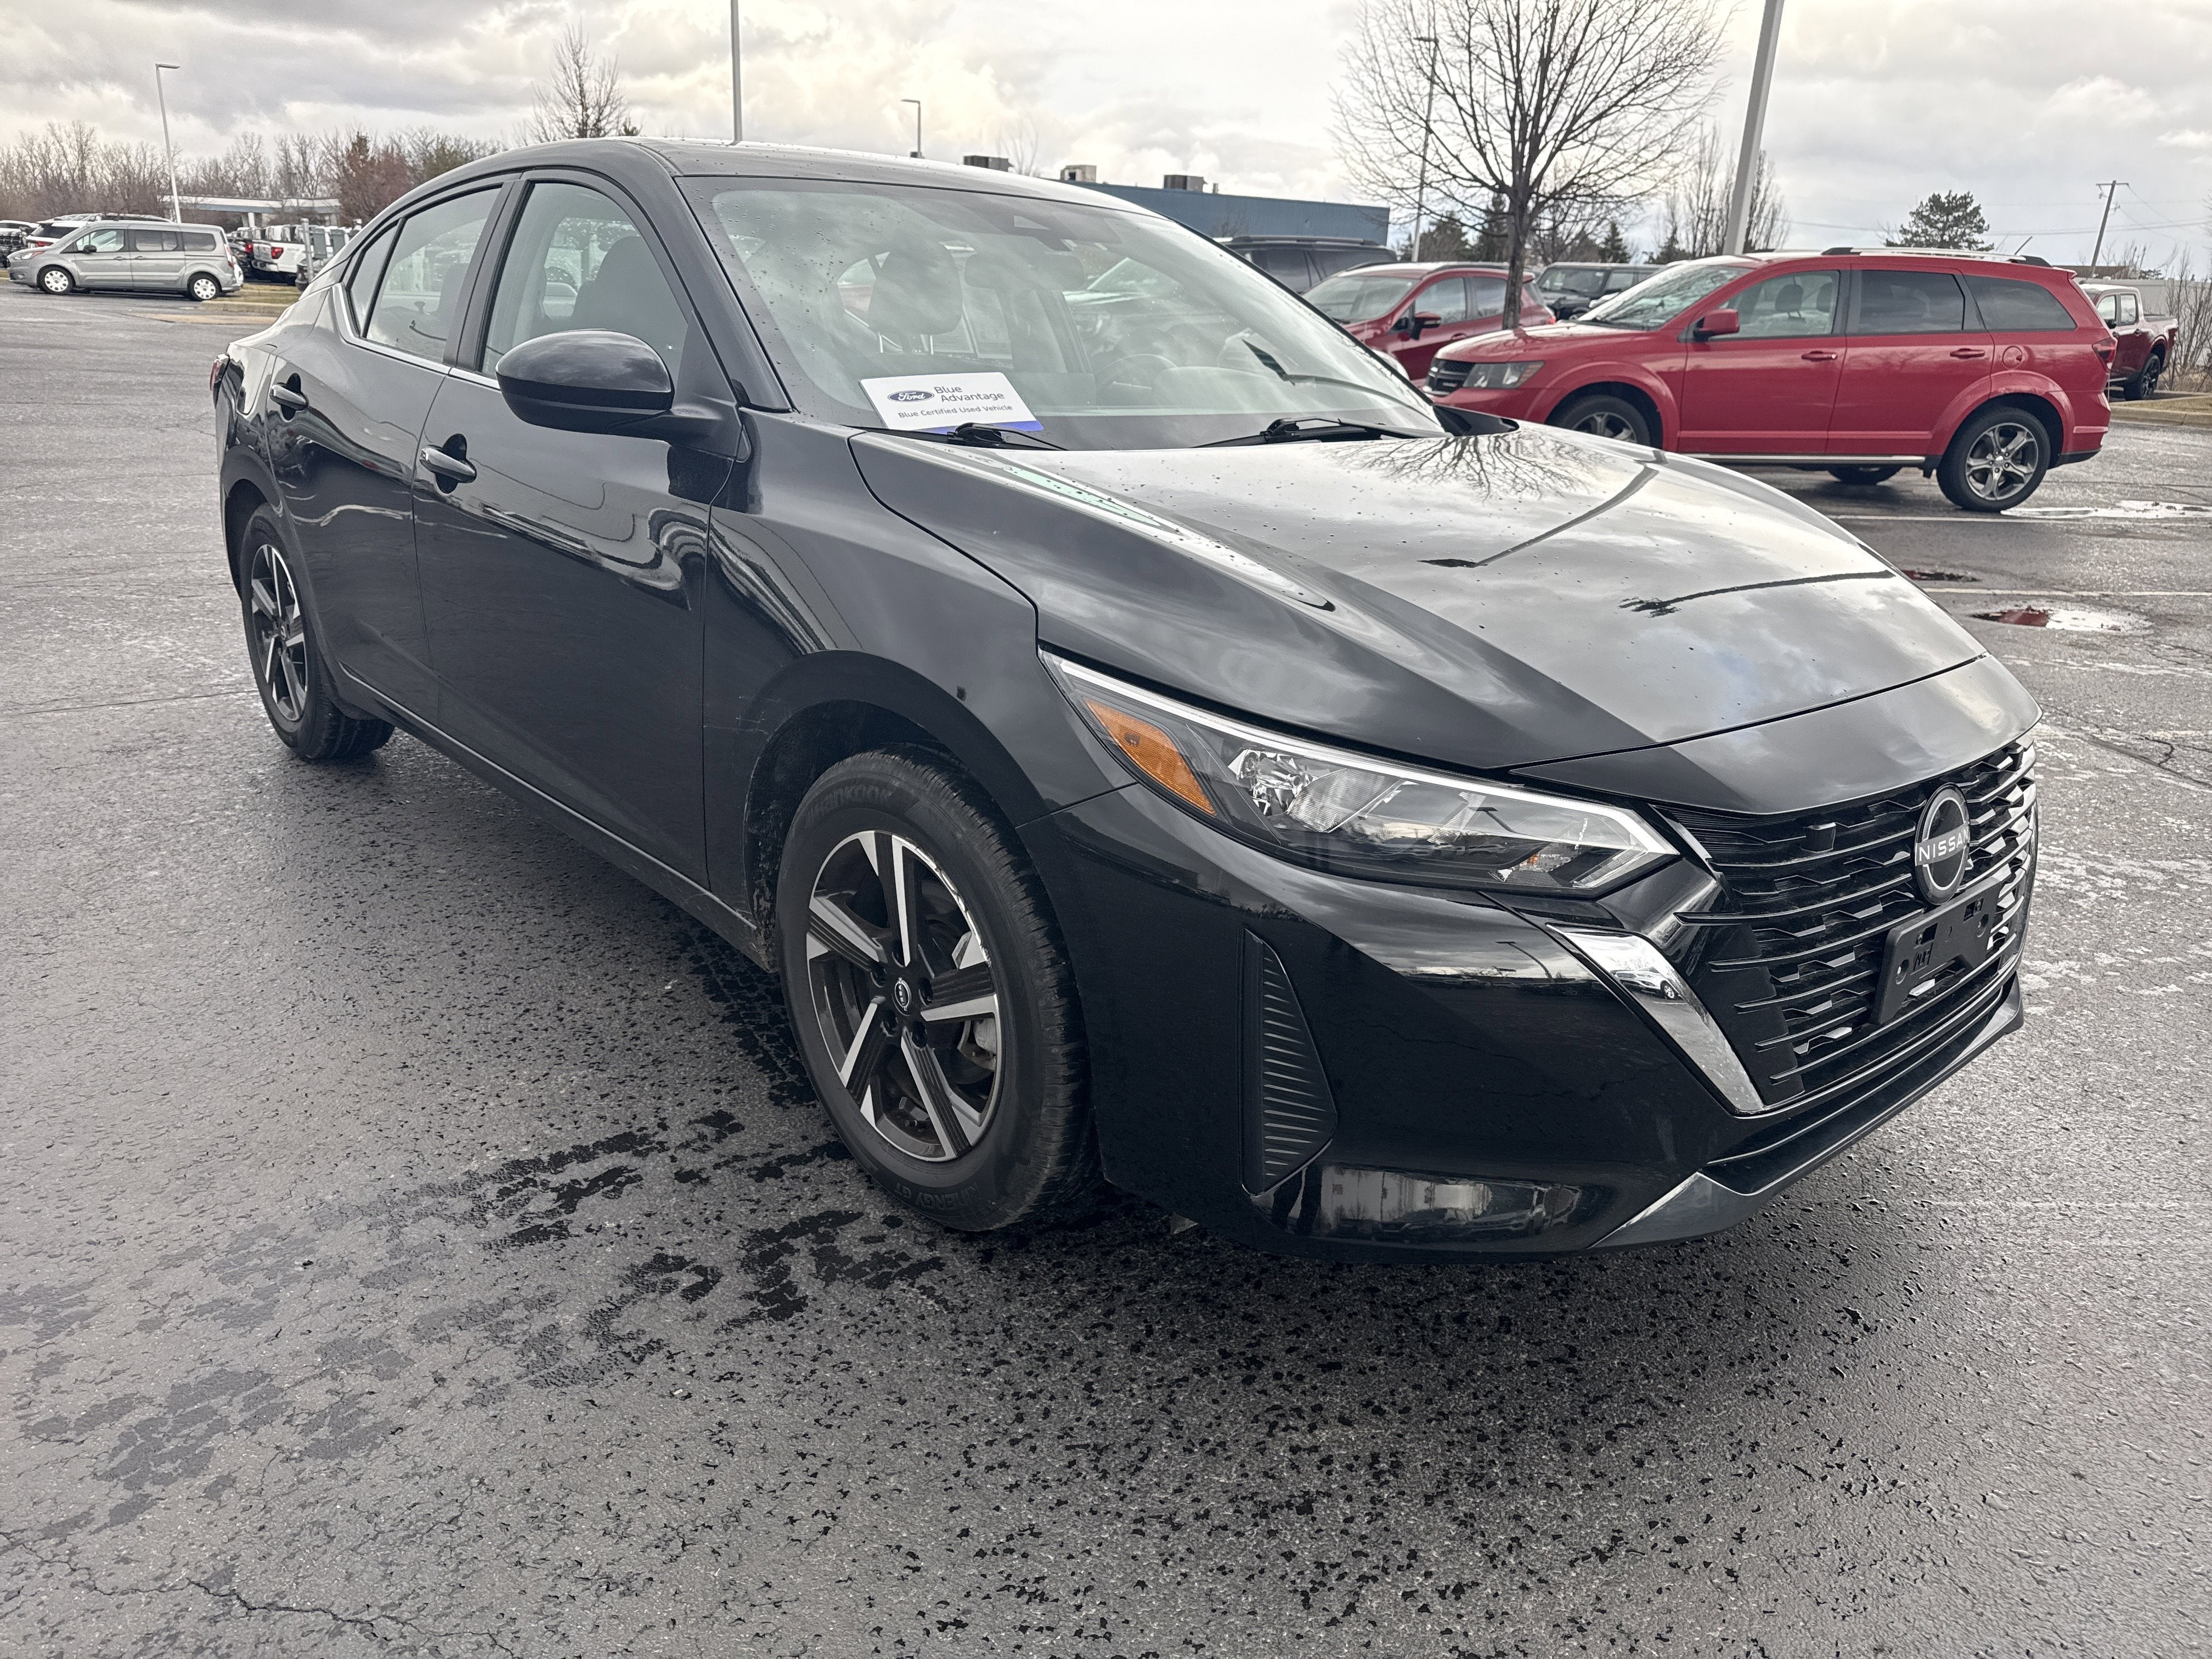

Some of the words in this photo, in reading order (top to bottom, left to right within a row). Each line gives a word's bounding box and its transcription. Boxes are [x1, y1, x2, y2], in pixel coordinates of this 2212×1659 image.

[934, 386, 962, 394] Blue
[898, 392, 926, 401] Ford
[941, 393, 1005, 402] Advantage
[920, 408, 958, 416] Certified
[1918, 826, 1969, 862] NISSAN
